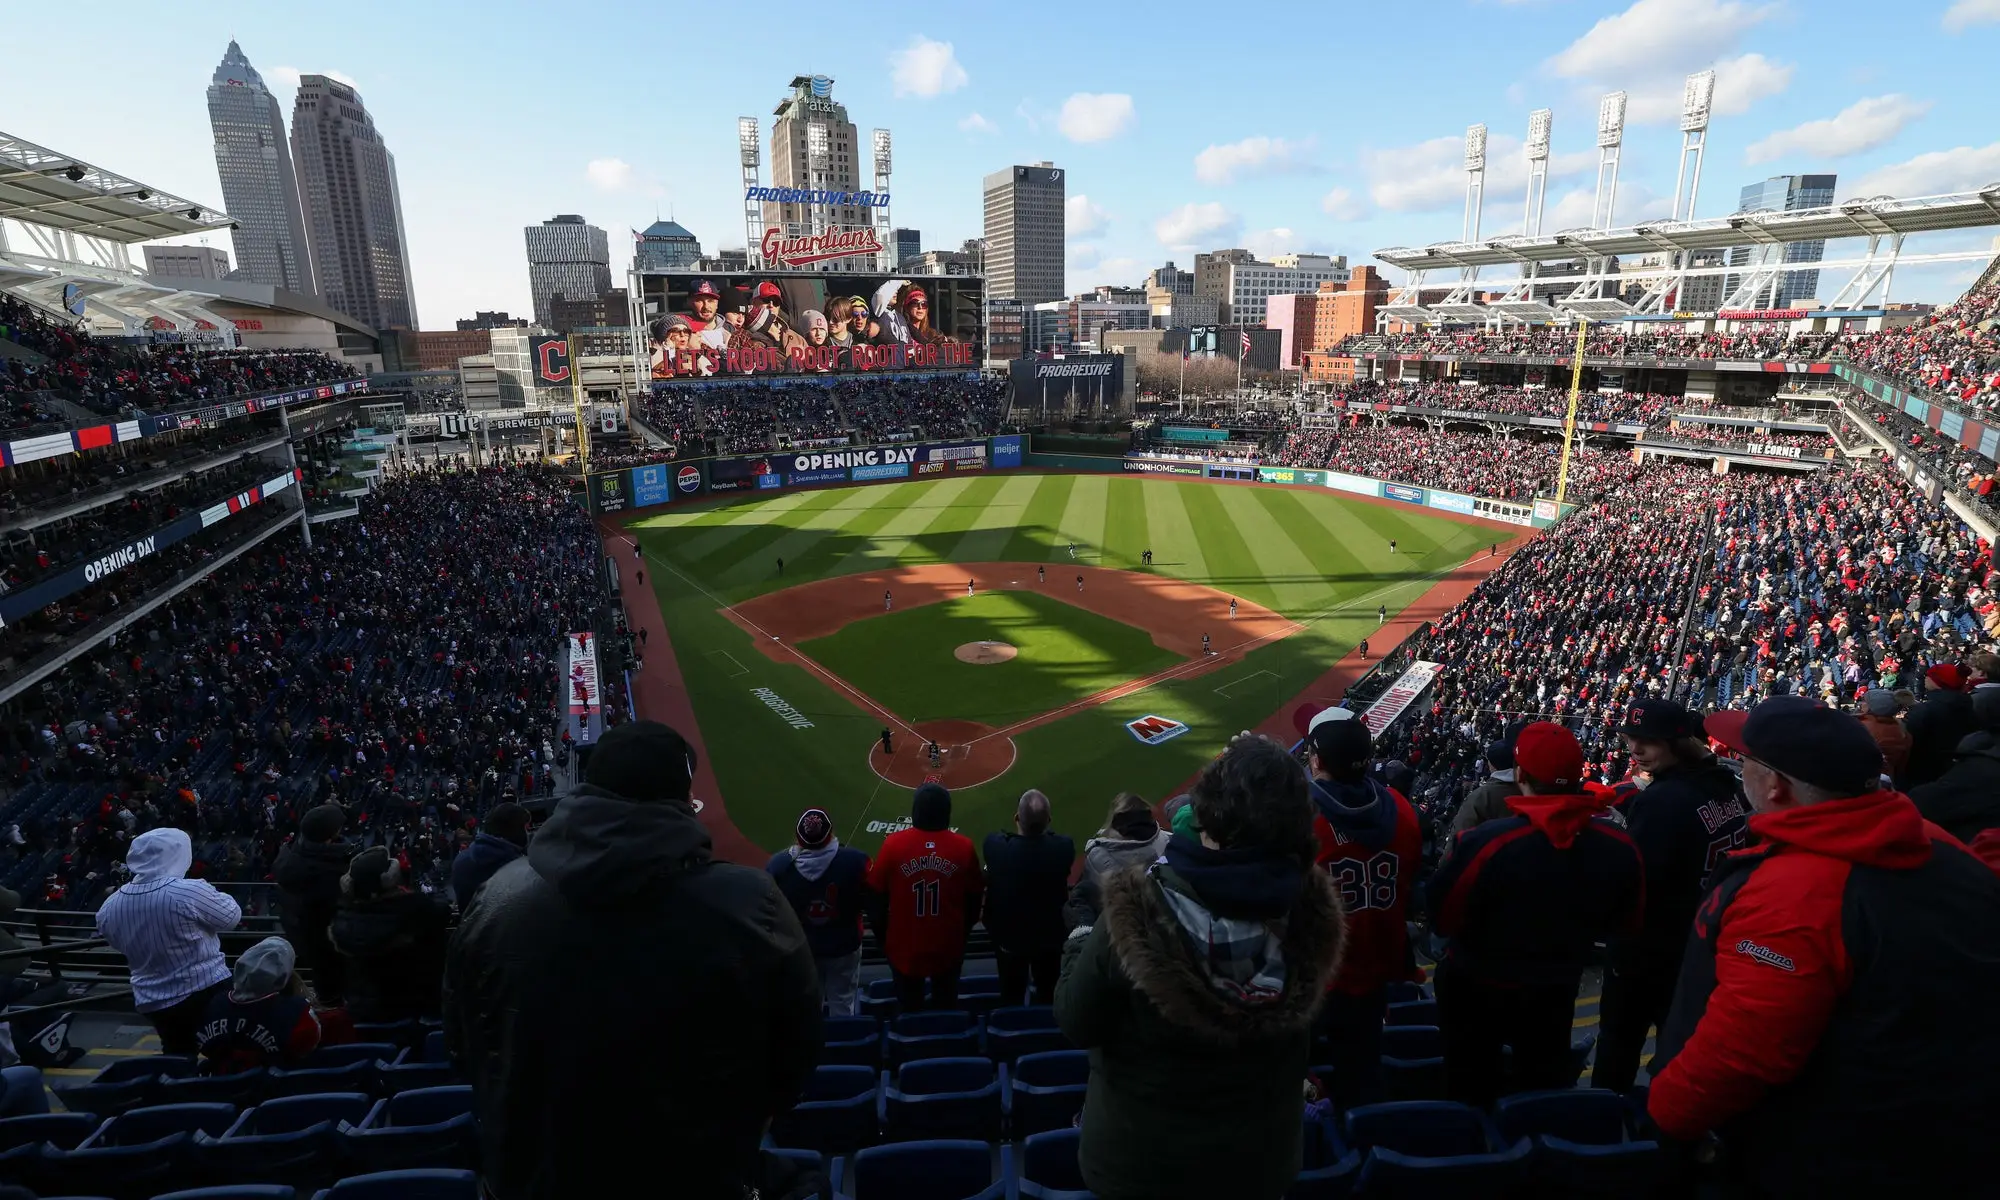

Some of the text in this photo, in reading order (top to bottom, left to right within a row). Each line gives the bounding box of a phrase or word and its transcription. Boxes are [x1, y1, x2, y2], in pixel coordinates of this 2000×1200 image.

[809, 101, 836, 113] at&t
[745, 186, 891, 207] PROGRESSIVE FIELD
[761, 225, 883, 268] Guardians
[1718, 309, 1807, 320] PENNANT DISTRICT
[538, 340, 570, 382] C
[662, 348, 720, 374] LET'S
[852, 343, 899, 368] ROOT
[904, 342, 937, 367] FOR
[943, 343, 974, 365] THE
[1037, 363, 1113, 378] PROGRESSIVE
[1441, 409, 1487, 419] OPENING DAY
[497, 415, 578, 429] BREWED IN OHIO
[994, 444, 1020, 455] meijer
[1747, 443, 1801, 458] THE CORNER
[794, 447, 917, 472] OPENING DAY
[853, 467, 904, 478] PROGRESSIVE
[918, 462, 944, 474] BLASTER
[603, 481, 617, 491] 811
[636, 484, 666, 493] Cleveland
[1495, 514, 1523, 524] CLIFFS
[84, 536, 156, 583] OPENING DAY
[750, 687, 815, 730] PROGRESSIVE
[1632, 710, 1644, 725] C
[1329, 852, 1399, 912] 38
[912, 879, 940, 917] 11
[1736, 939, 1795, 971] Indians
